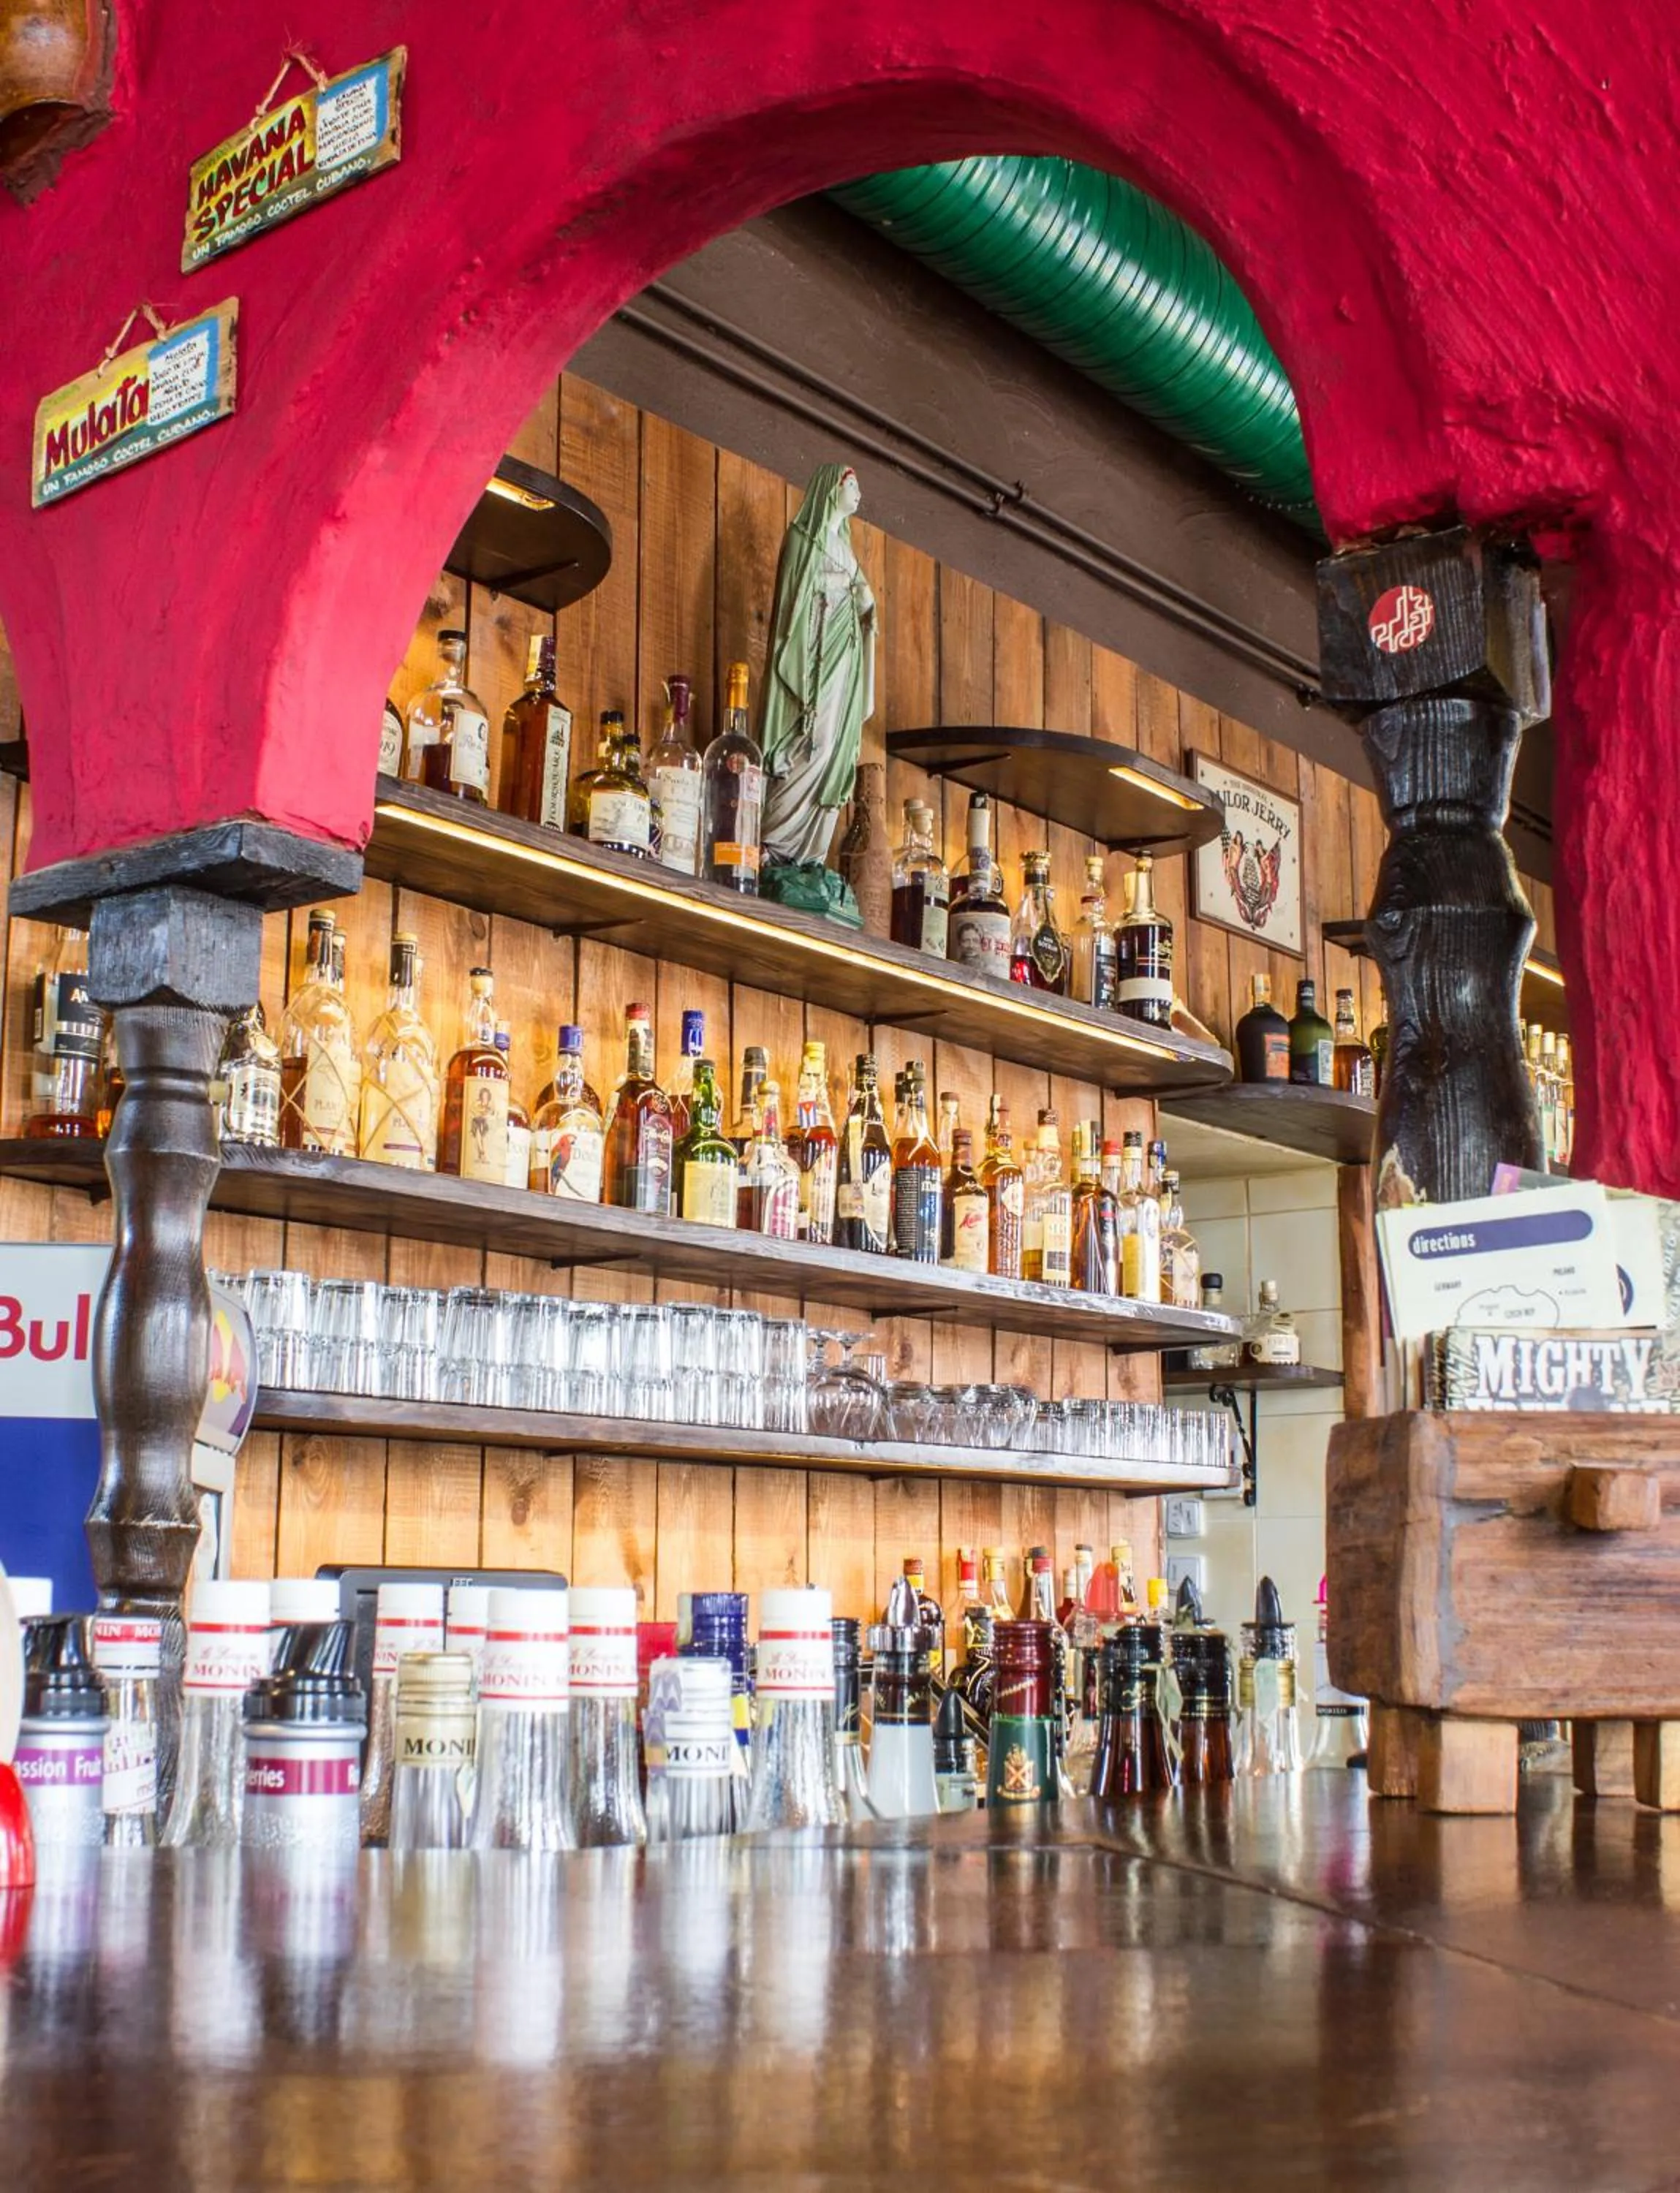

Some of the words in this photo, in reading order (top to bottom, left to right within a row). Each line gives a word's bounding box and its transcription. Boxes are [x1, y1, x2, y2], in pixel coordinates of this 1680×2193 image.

[193, 139, 315, 242] SPECIAL
[192, 241, 211, 260] UN
[267, 188, 311, 216] COCTEL
[45, 374, 150, 479] Mulata
[42, 480, 59, 496] UN
[1252, 801, 1291, 839] JERRY
[1412, 1232, 1476, 1256] directions
[0, 1293, 91, 1362] Bul
[1474, 1336, 1654, 1400] MIGHTY
[194, 1663, 262, 1677] MONIN
[765, 1667, 826, 1681] MONIN
[404, 1738, 475, 1755] MONI
[666, 1745, 726, 1762] MONI
[15, 1756, 67, 1779] assion
